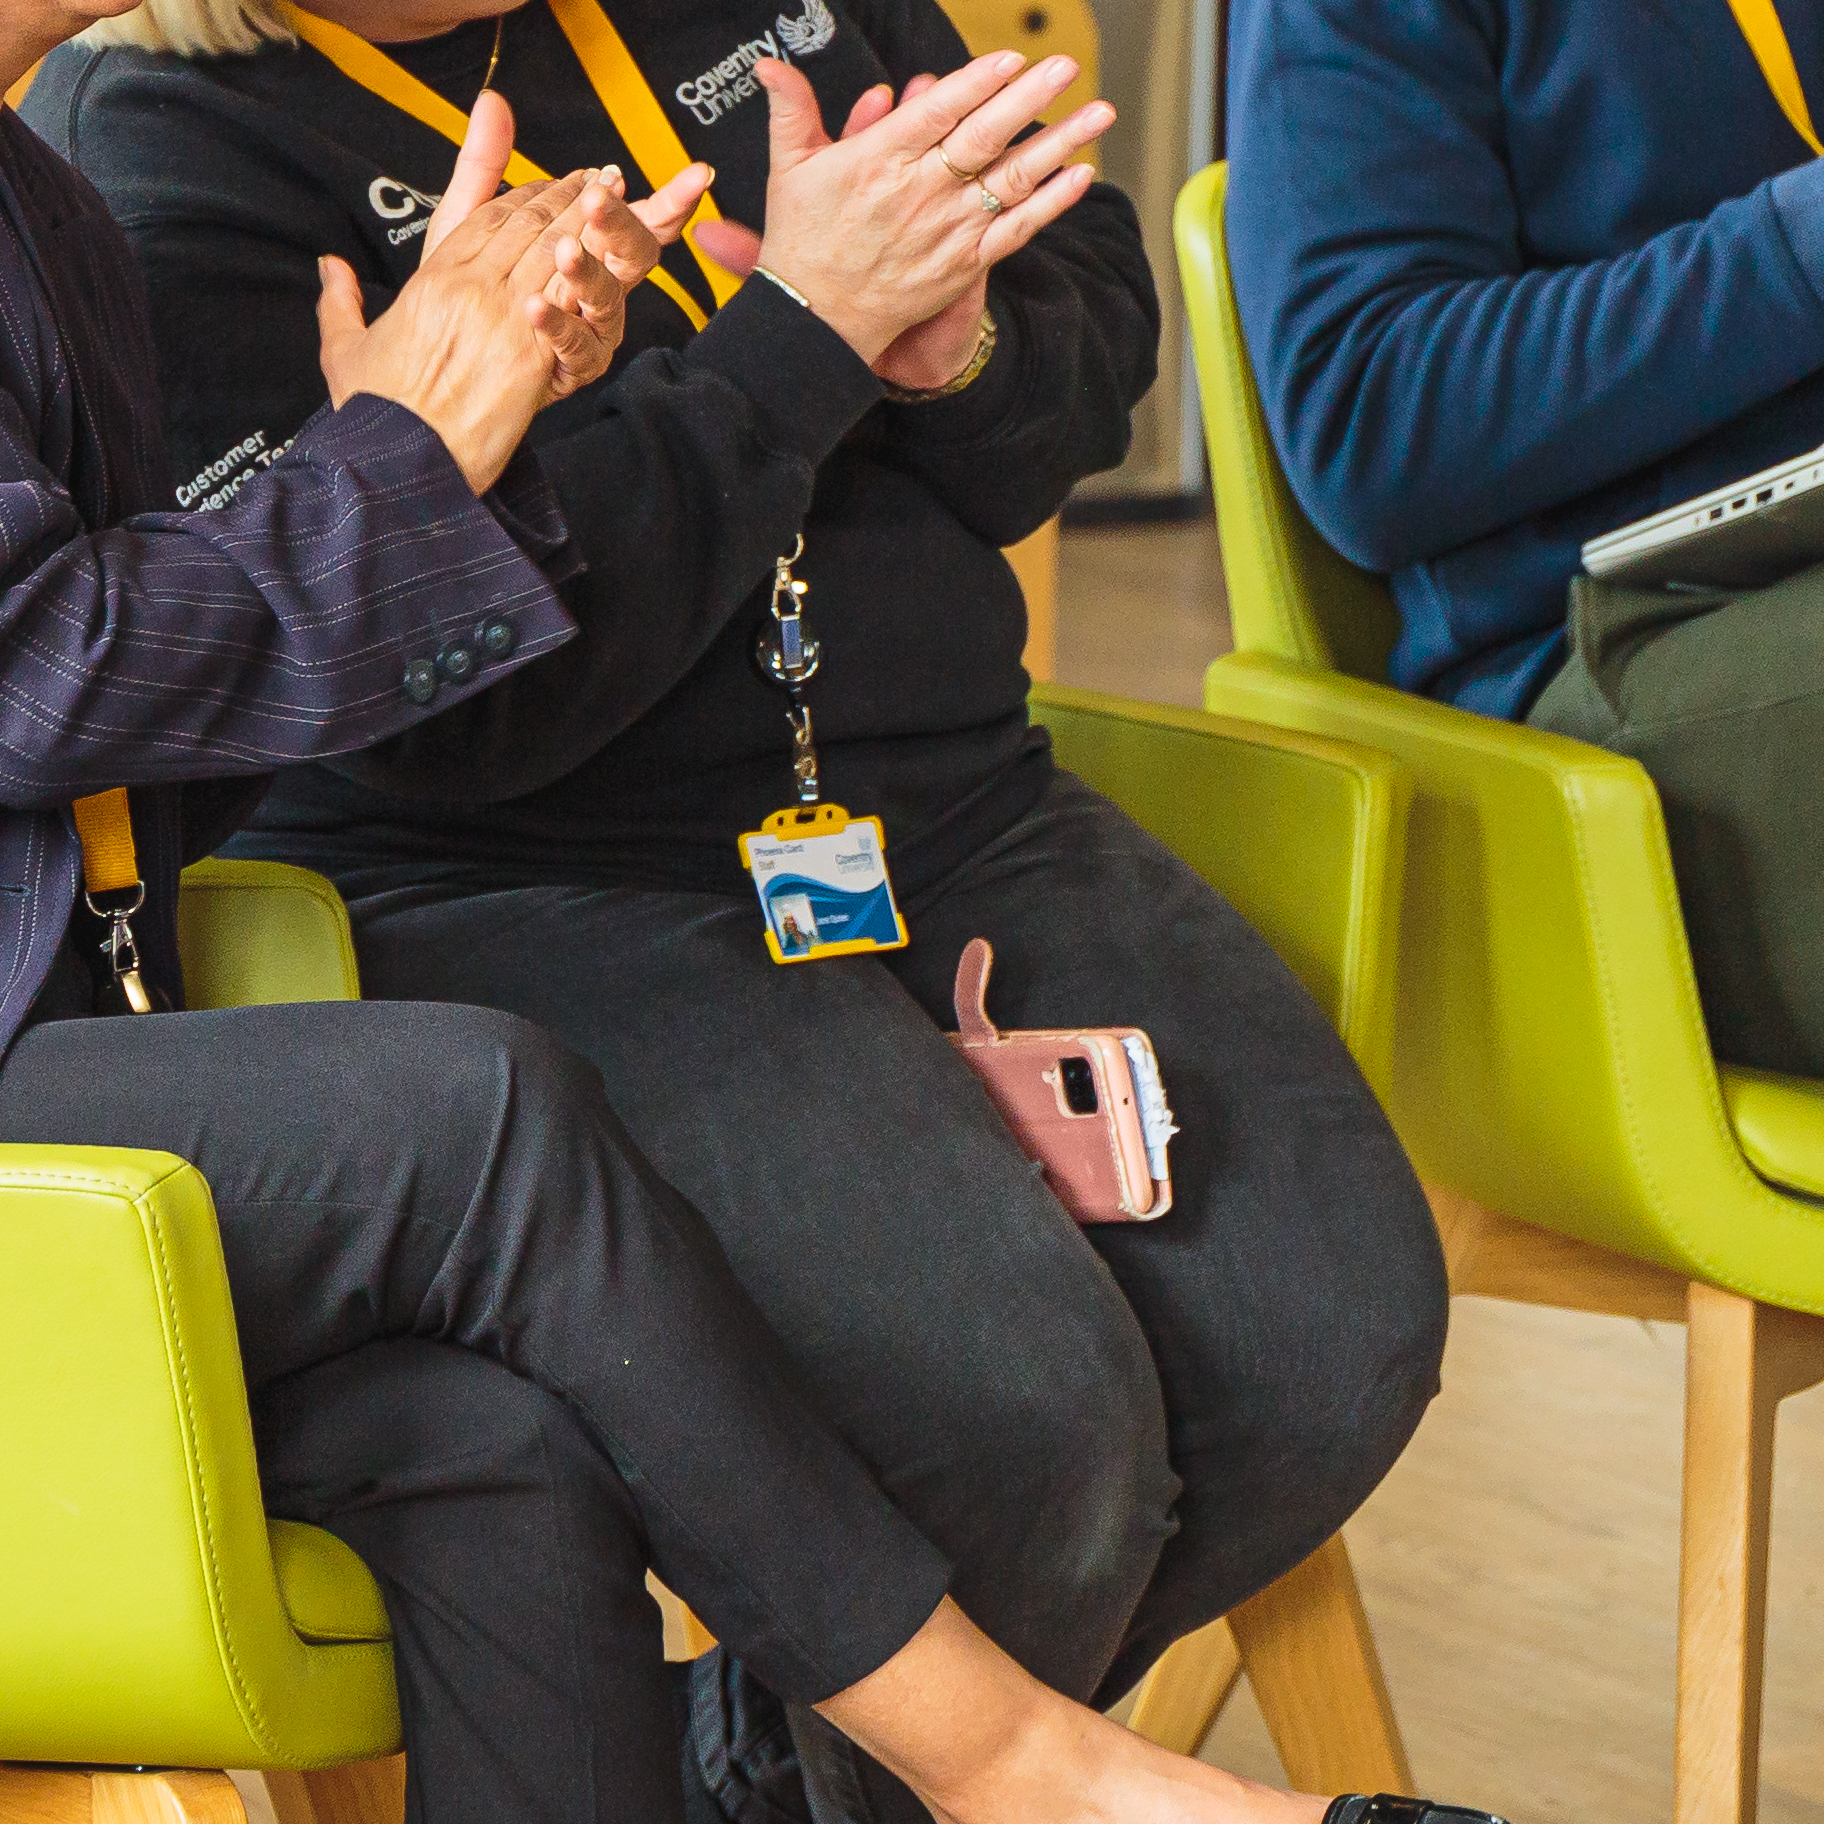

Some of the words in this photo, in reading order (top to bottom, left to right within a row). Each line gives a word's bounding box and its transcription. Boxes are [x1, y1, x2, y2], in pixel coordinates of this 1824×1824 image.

[676, 30, 780, 106] Coventry
[387, 217, 431, 246] Coven
[176, 430, 266, 508] Customer
[195, 468, 256, 513] ience
